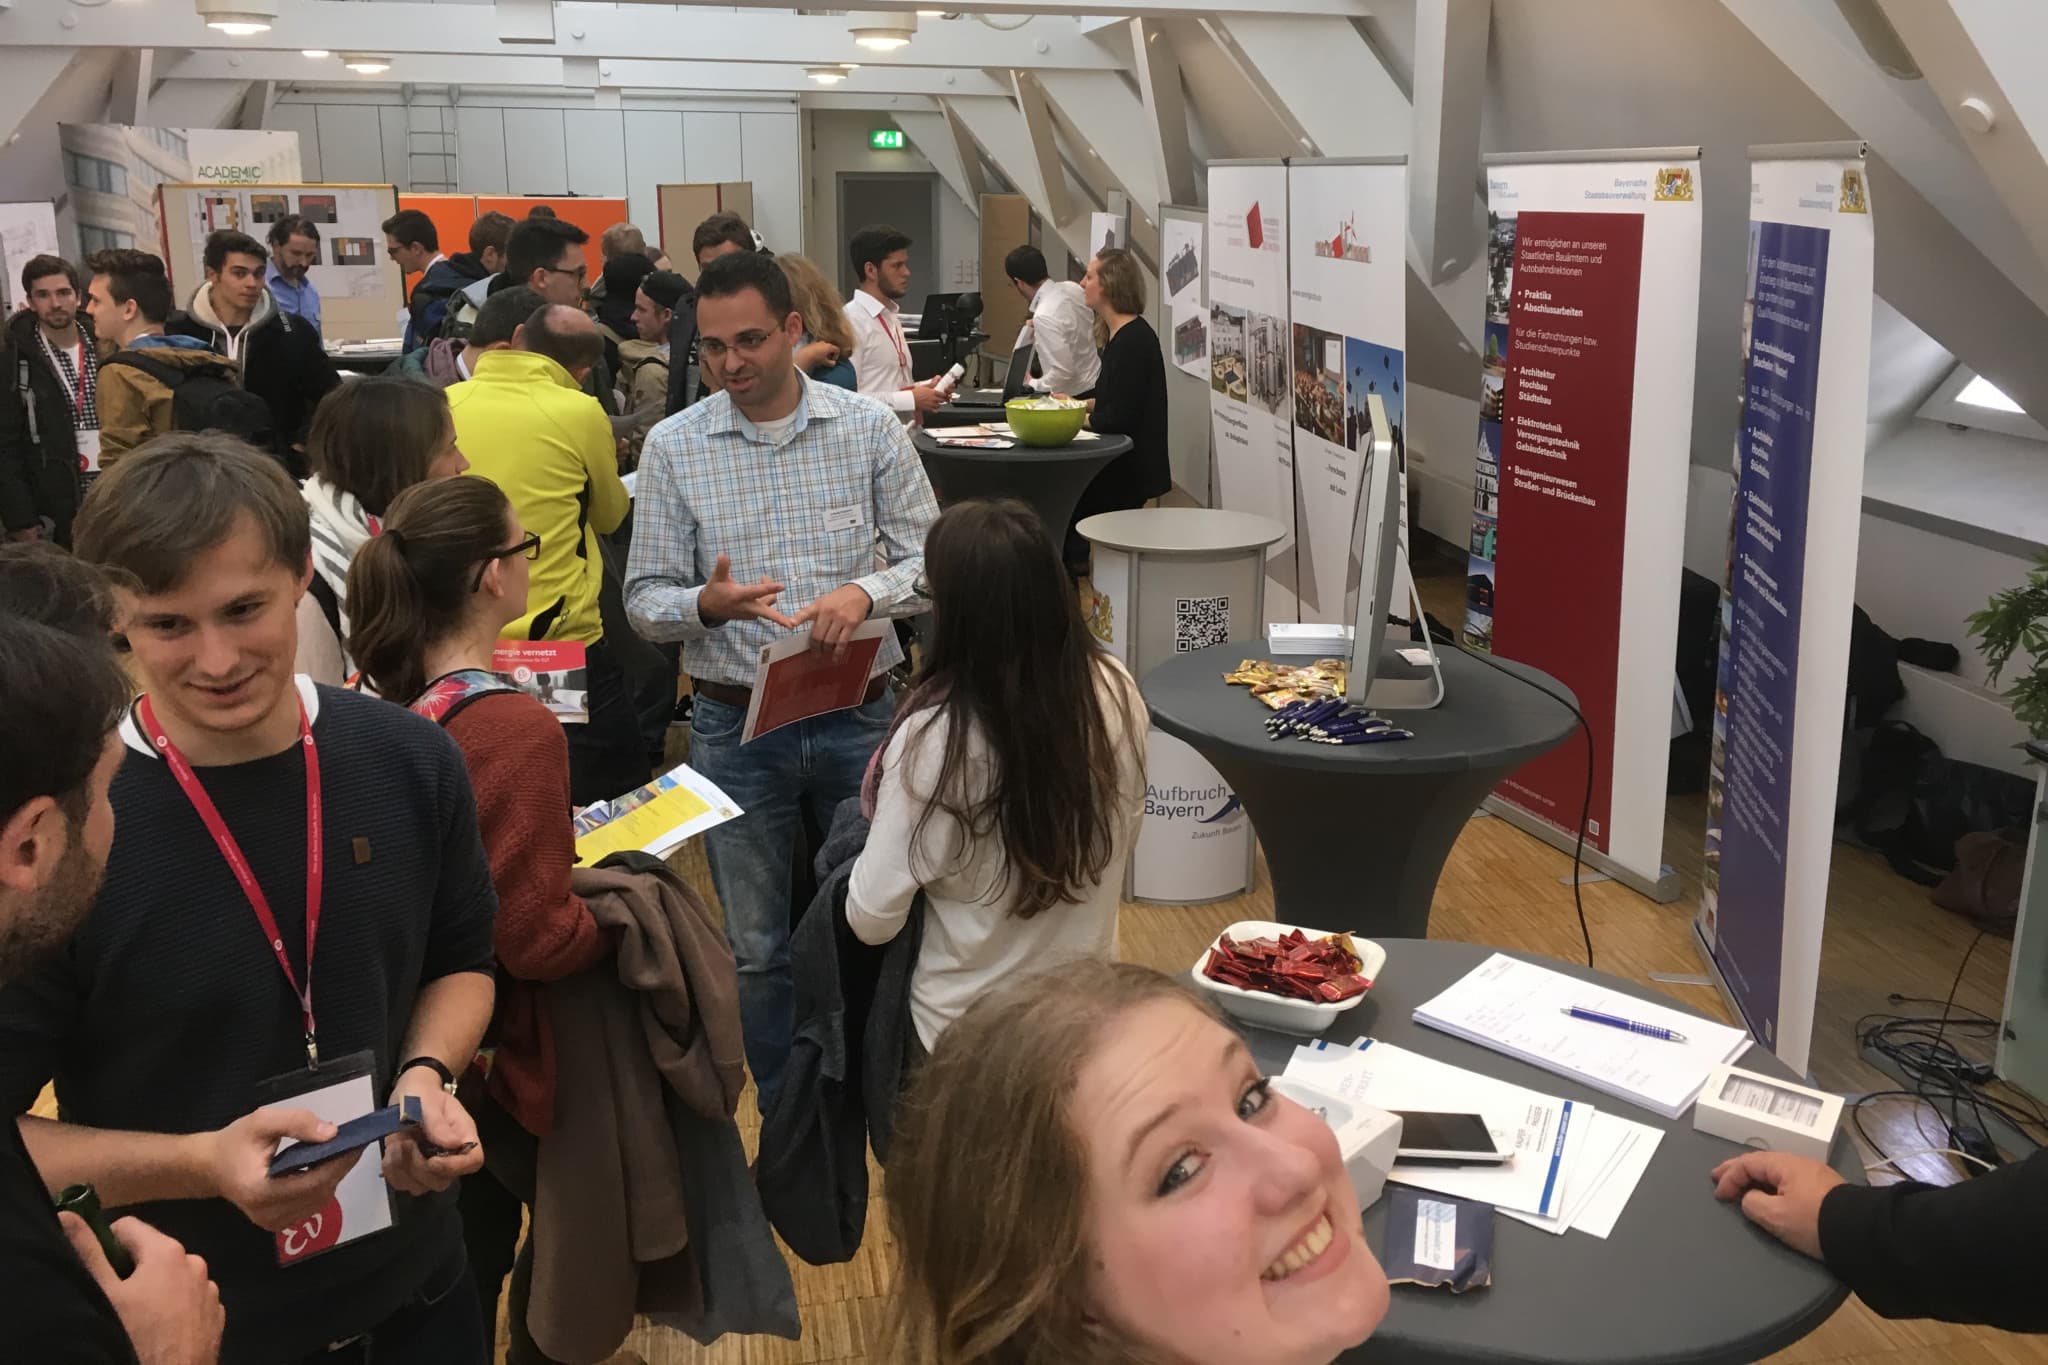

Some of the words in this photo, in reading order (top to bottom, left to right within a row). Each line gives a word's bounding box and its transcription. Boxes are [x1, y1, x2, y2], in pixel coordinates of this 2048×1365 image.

[198, 166, 262, 179] ACADEMIC
[1522, 237, 1533, 247] Wir
[1534, 238, 1571, 249] ermöglichen
[1572, 241, 1581, 249] an
[1581, 241, 1607, 251] unseren
[1521, 250, 1555, 260] Staatlichen
[1590, 254, 1602, 264] und
[1524, 289, 1552, 300] Praktika
[1523, 302, 1583, 317] Abschlussarbeiten
[1526, 329, 1536, 338] die
[1520, 366, 1556, 380] Architektur
[1519, 379, 1548, 391] Hochbau
[1518, 391, 1552, 405] Städtebau
[1517, 416, 1563, 433] Elektrotechnik
[1516, 428, 1580, 450] Versorgungstechnik
[1515, 441, 1567, 460] Gebäudetechnik
[1514, 465, 1577, 488] Bauingenieurwesen
[1542, 487, 1556, 496] und
[1556, 488, 1596, 506] Brückenbau
[494, 648, 520, 657] nergie
[522, 649, 557, 657] vernetzt
[1146, 784, 1226, 801] Aufbruch
[1145, 800, 1204, 820] Bayern
[1192, 829, 1220, 840] Zukunft
